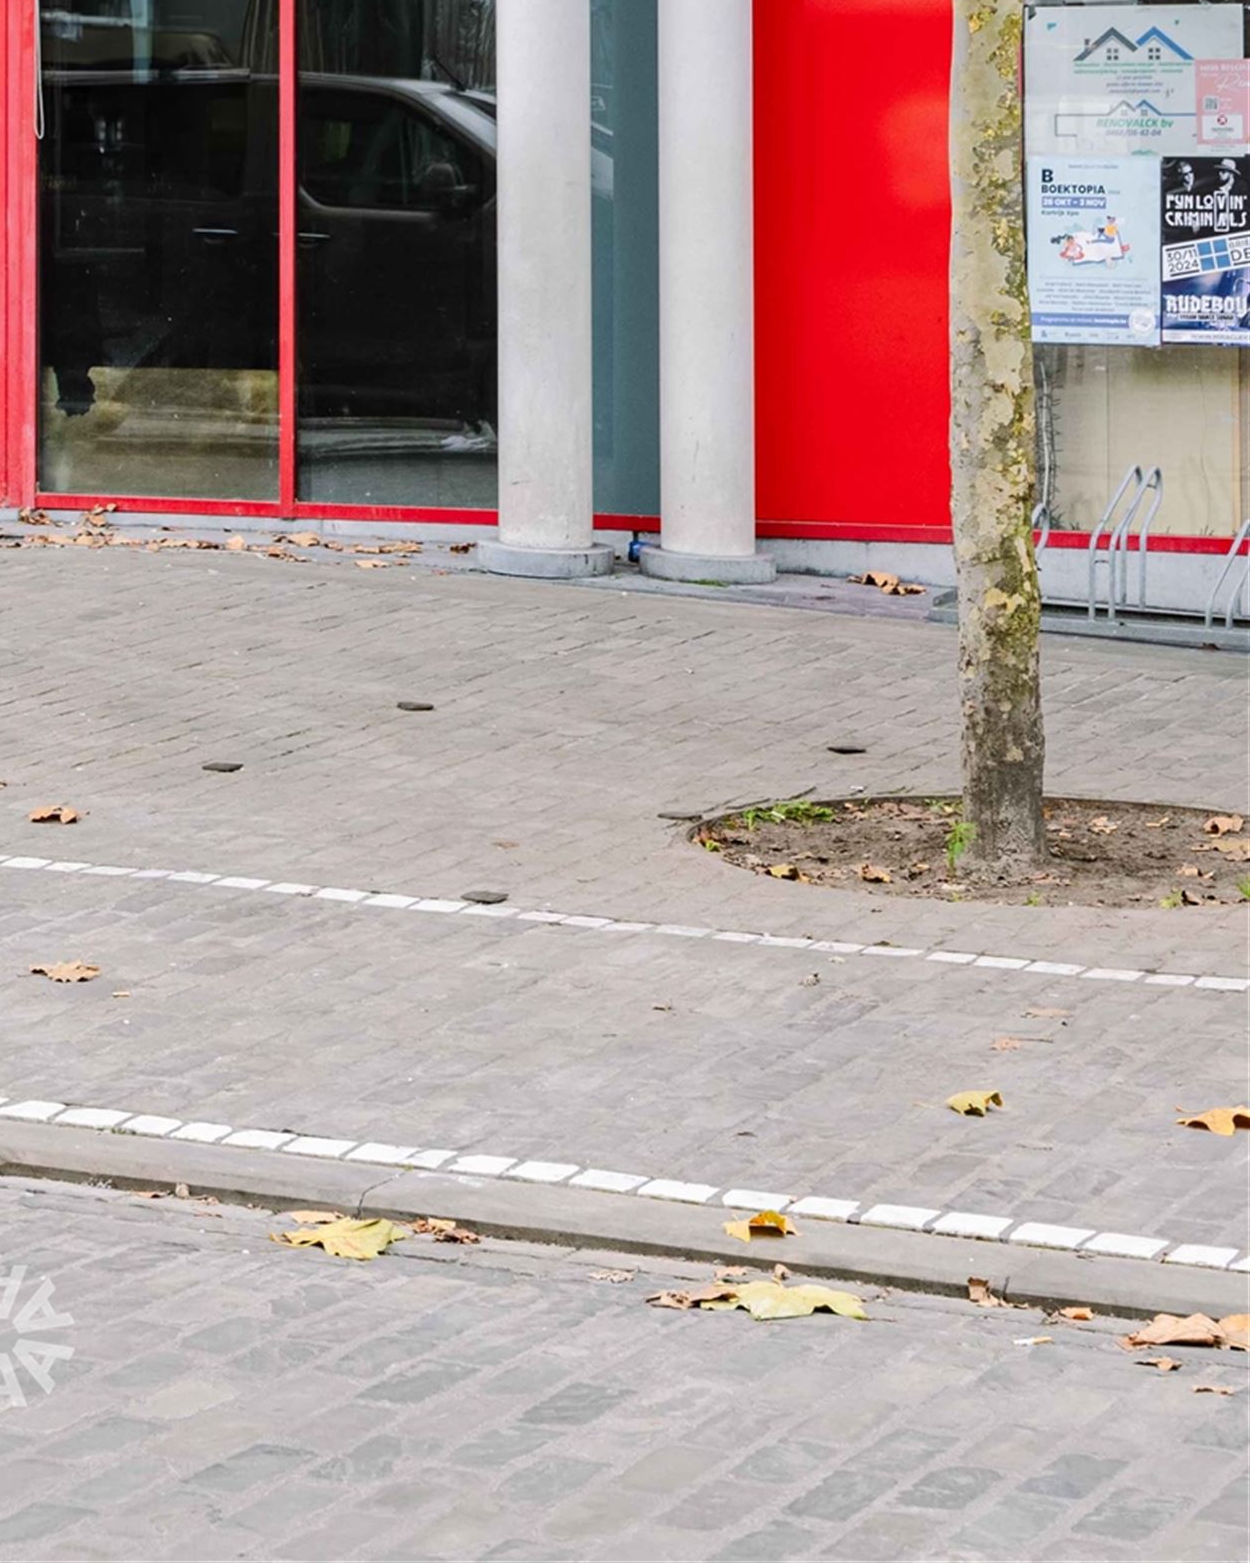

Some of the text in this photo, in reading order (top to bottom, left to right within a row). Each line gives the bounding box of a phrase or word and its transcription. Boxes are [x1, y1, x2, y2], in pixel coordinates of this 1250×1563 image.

[1041, 169, 1054, 183] B
[1041, 184, 1106, 194] BOEKTOPIA
[1054, 198, 1072, 207] OKT
[1087, 198, 1106, 207] NOV
[1165, 211, 1248, 228] CRIMINALS
[1166, 247, 1198, 263] 30/11
[1168, 258, 1199, 273] 2024
[1163, 294, 1248, 318] RUDEBOY
